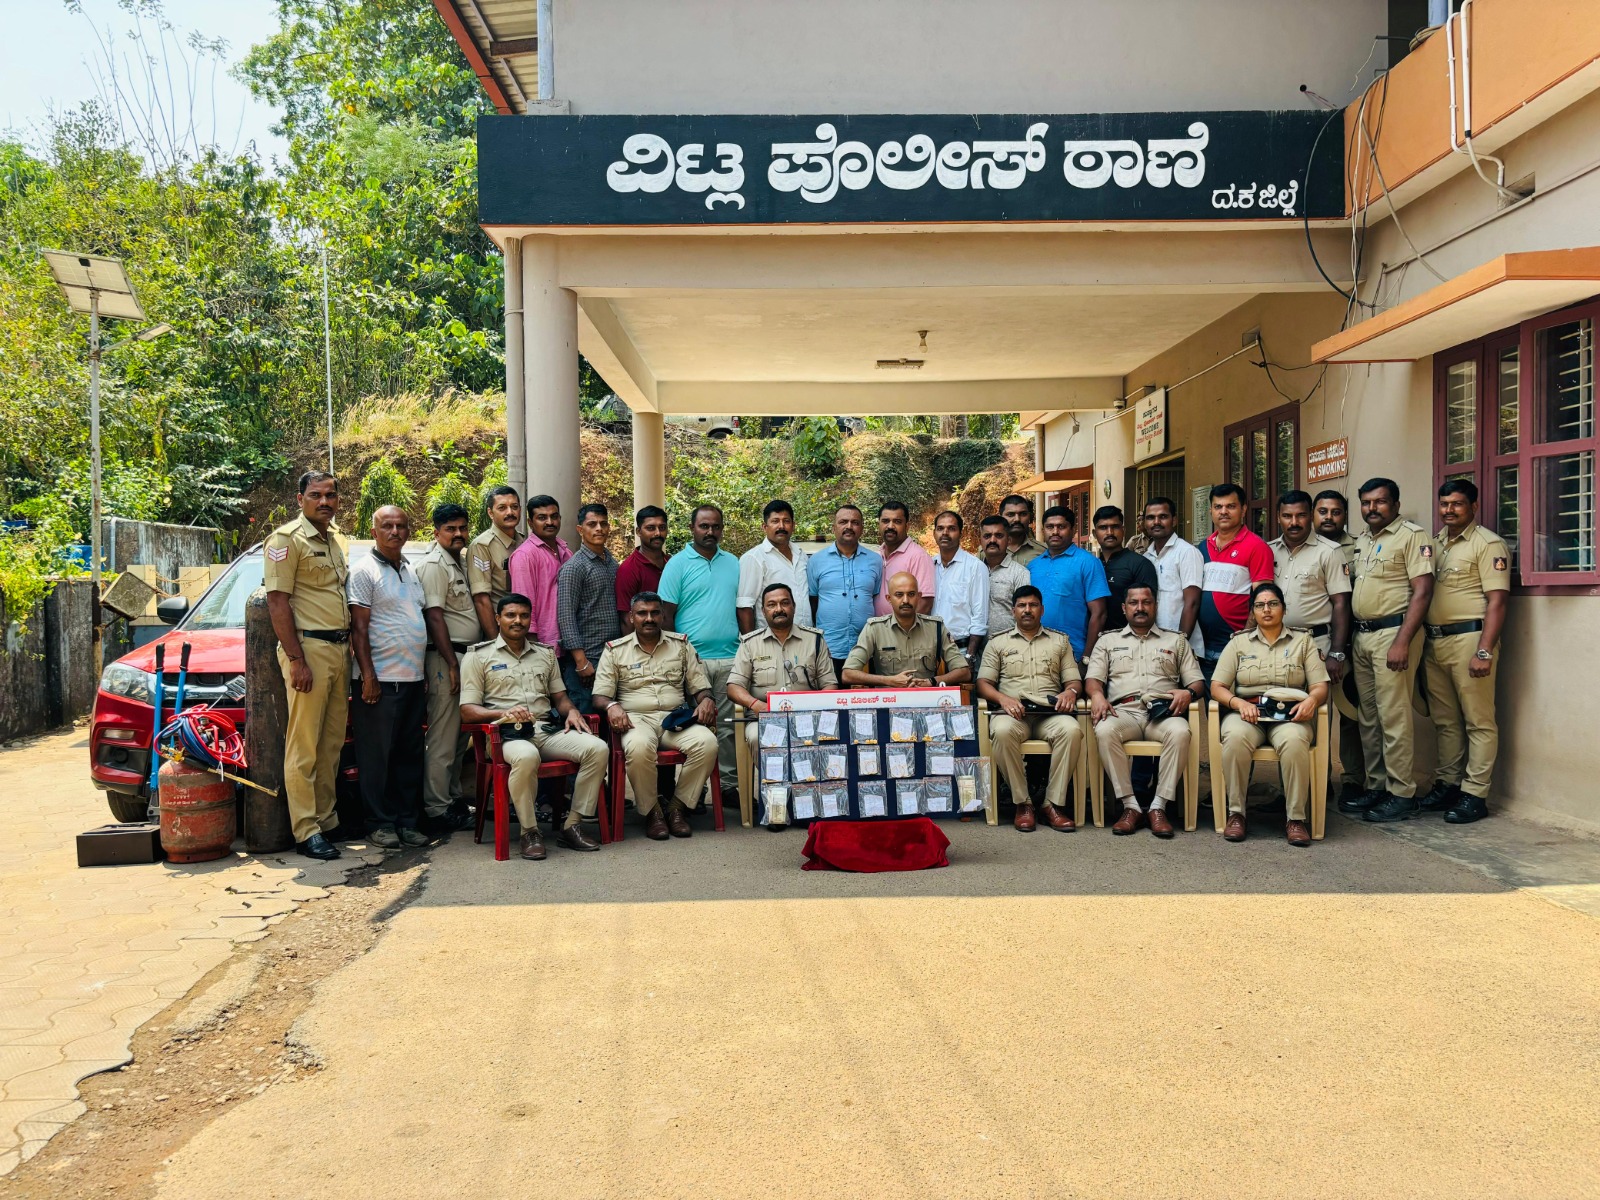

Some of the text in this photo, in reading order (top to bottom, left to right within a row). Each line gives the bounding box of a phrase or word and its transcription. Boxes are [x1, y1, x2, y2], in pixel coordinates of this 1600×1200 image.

[606, 121, 1209, 210] ವಿಟ್ಲ ಪೊಲೀಸ್ ಠಾಣೆ
[1258, 179, 1299, 216] ಜಿಲ್ಲೆ
[1309, 459, 1346, 479] NO SMOKING
